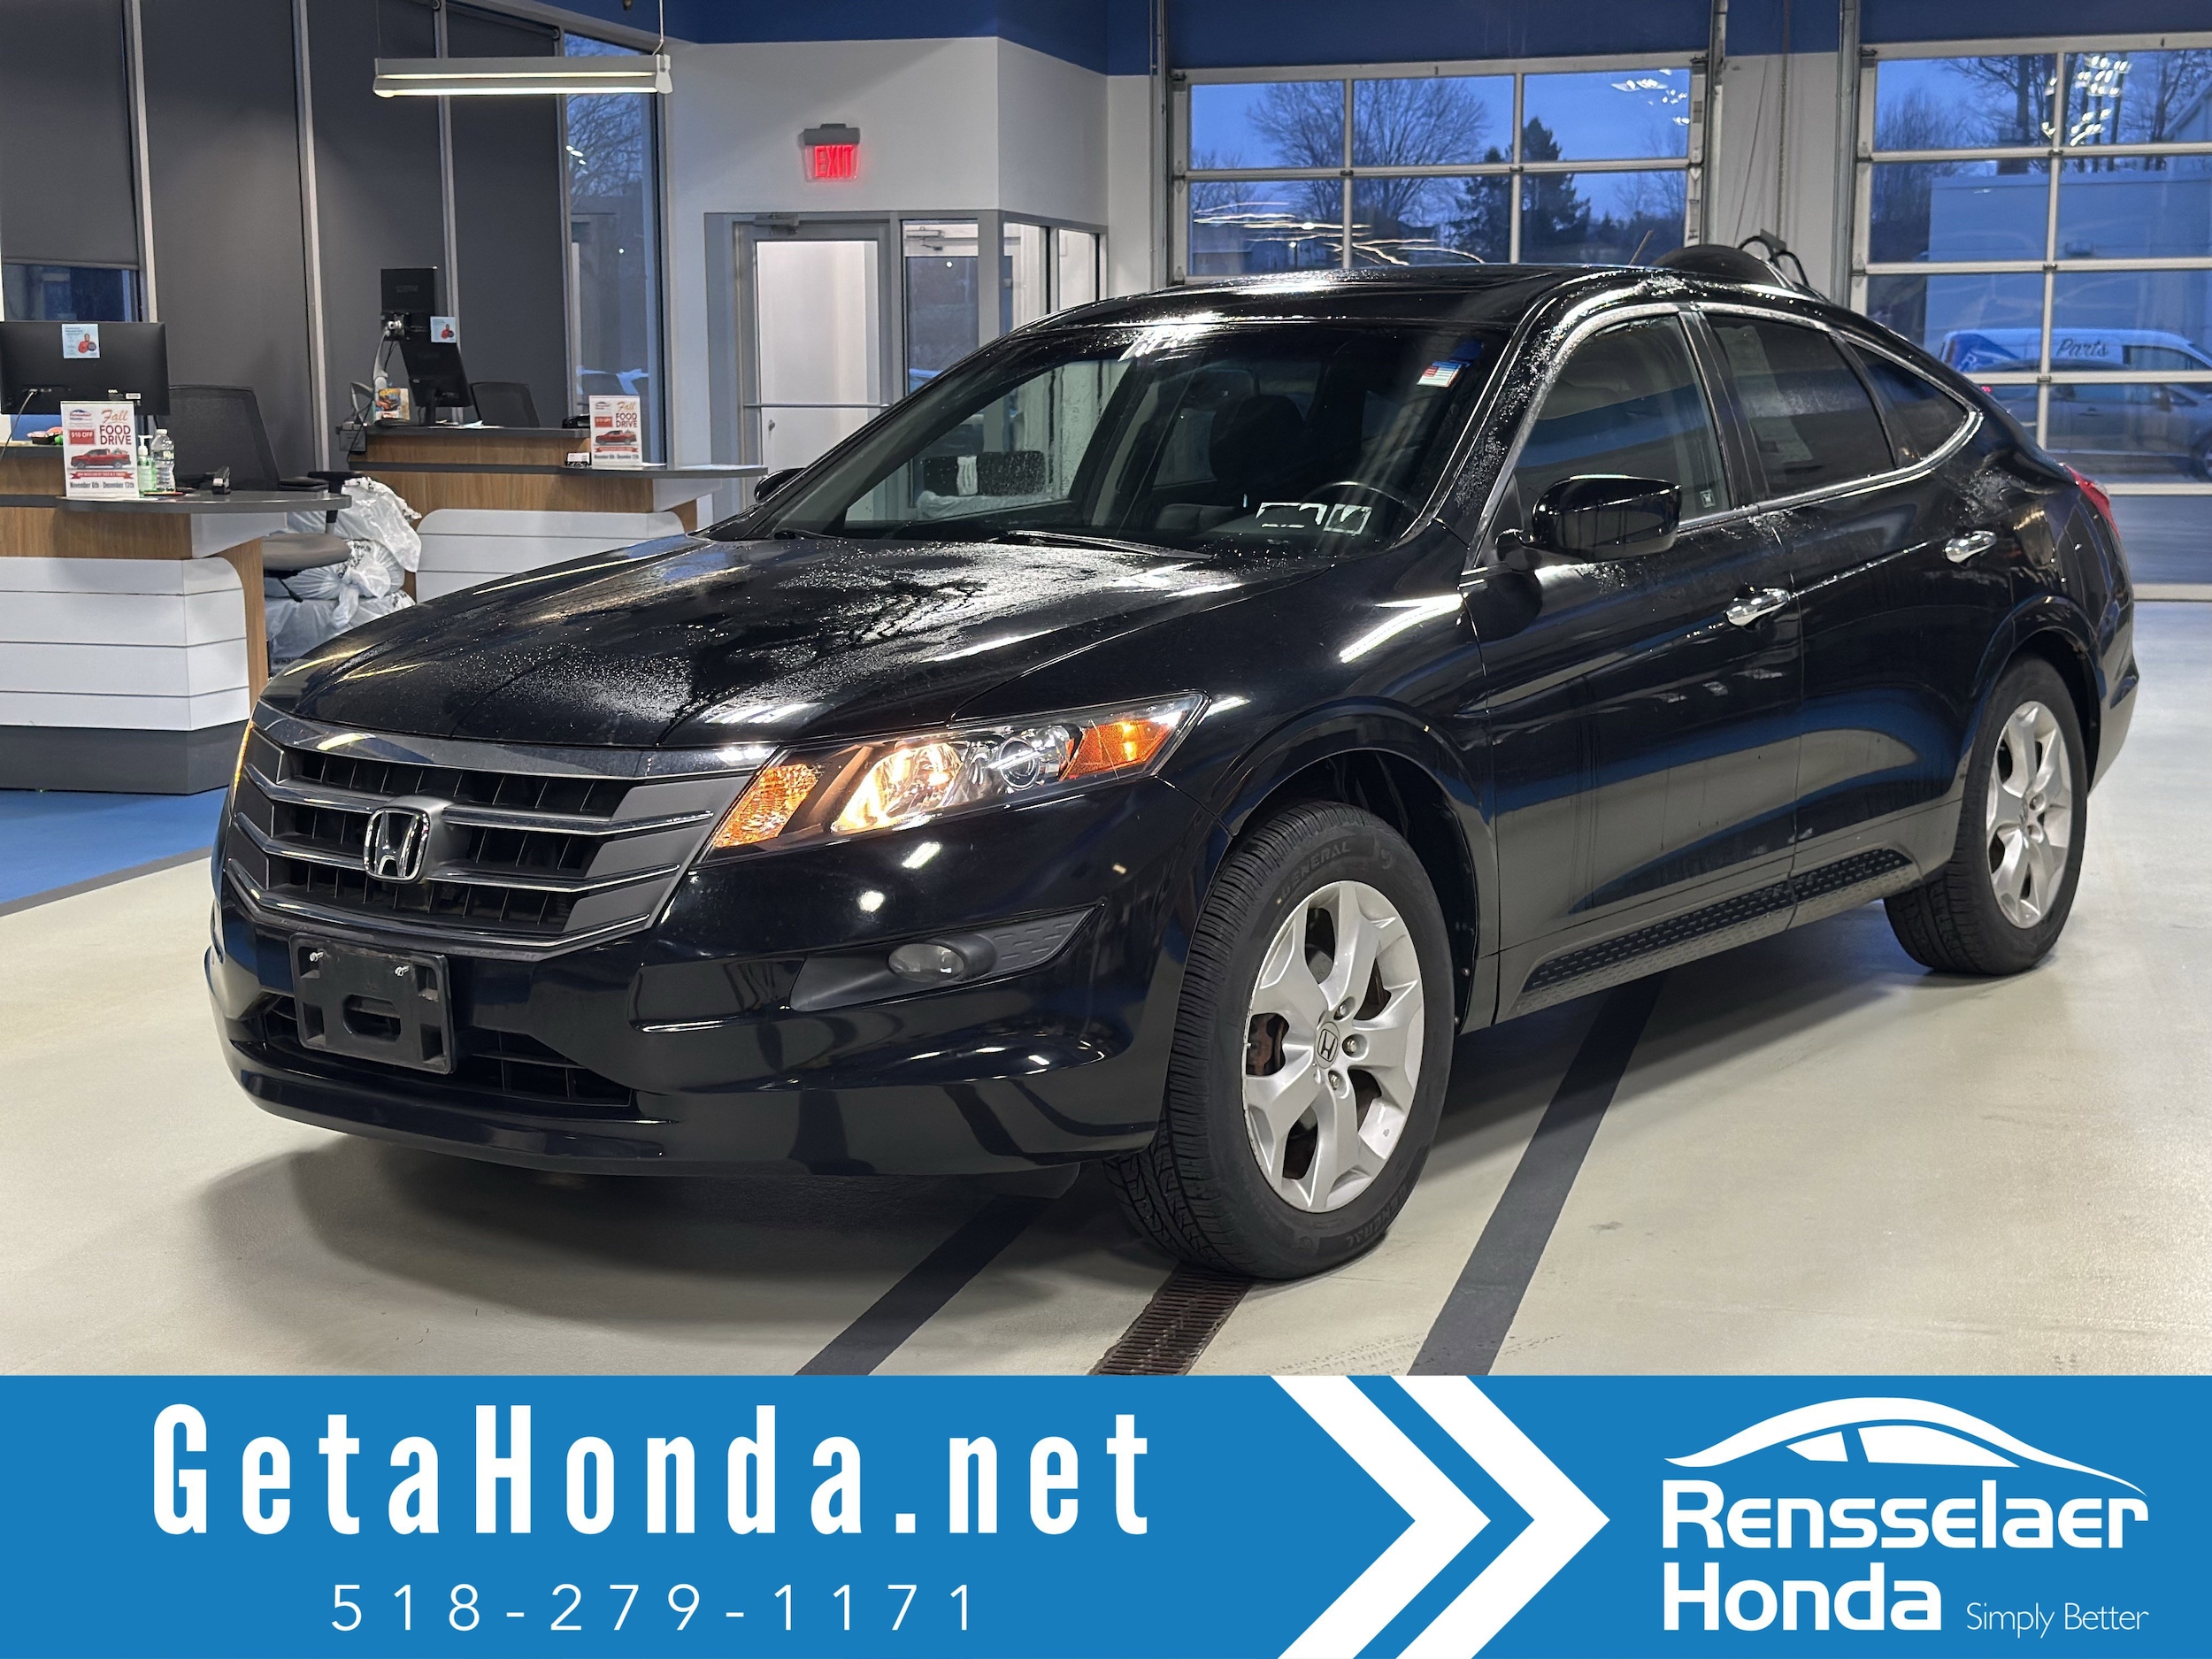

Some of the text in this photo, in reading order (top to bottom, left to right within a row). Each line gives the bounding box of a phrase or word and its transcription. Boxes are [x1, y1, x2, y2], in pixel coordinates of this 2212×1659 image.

[815, 145, 854, 178] EXIT
[2057, 338, 2109, 357] Parts
[618, 402, 636, 412] Fall
[101, 409, 129, 424] Fall
[100, 425, 132, 435] FOOD
[100, 434, 133, 445] DRIVE
